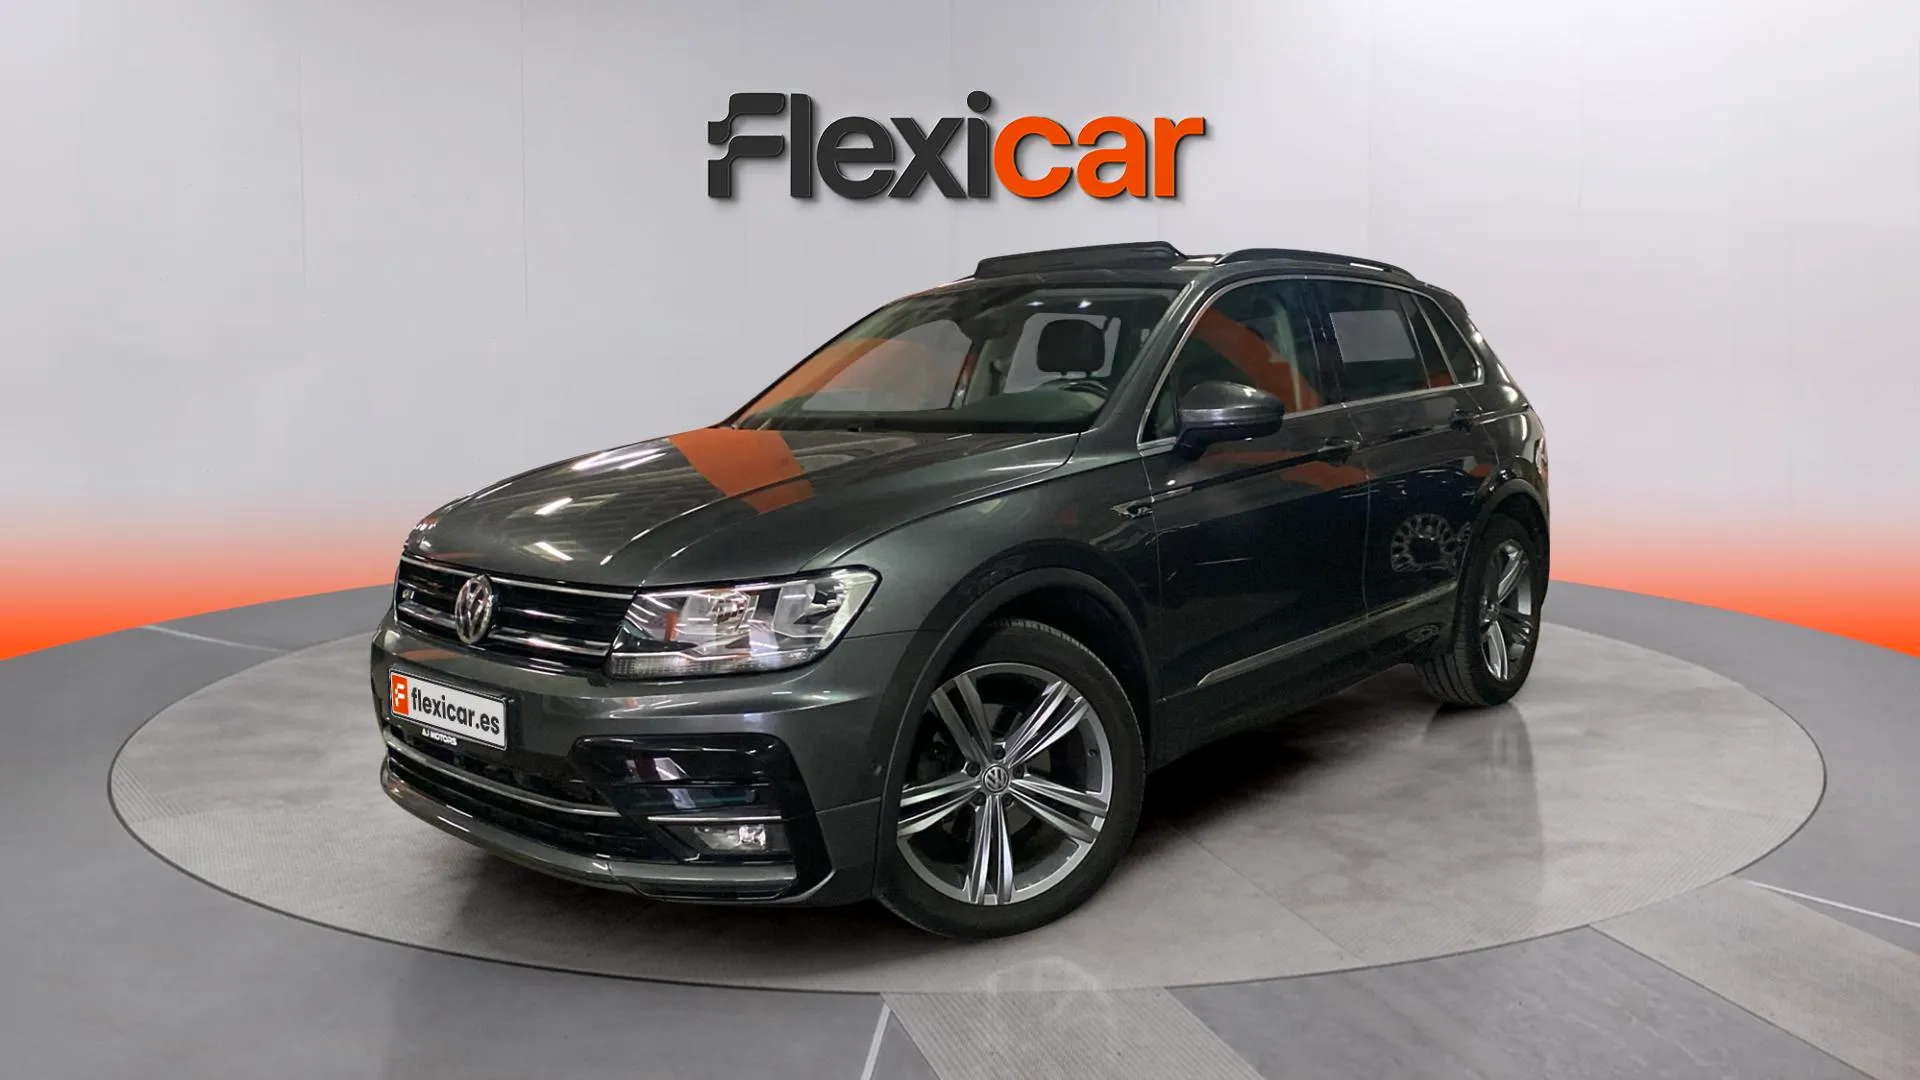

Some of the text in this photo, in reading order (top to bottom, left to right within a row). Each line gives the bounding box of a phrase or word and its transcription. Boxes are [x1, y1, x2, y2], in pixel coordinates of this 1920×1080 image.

[707, 90, 1204, 199] Flexicar
[411, 687, 500, 735] flexicar.es
[430, 731, 458, 746] MOTORS
